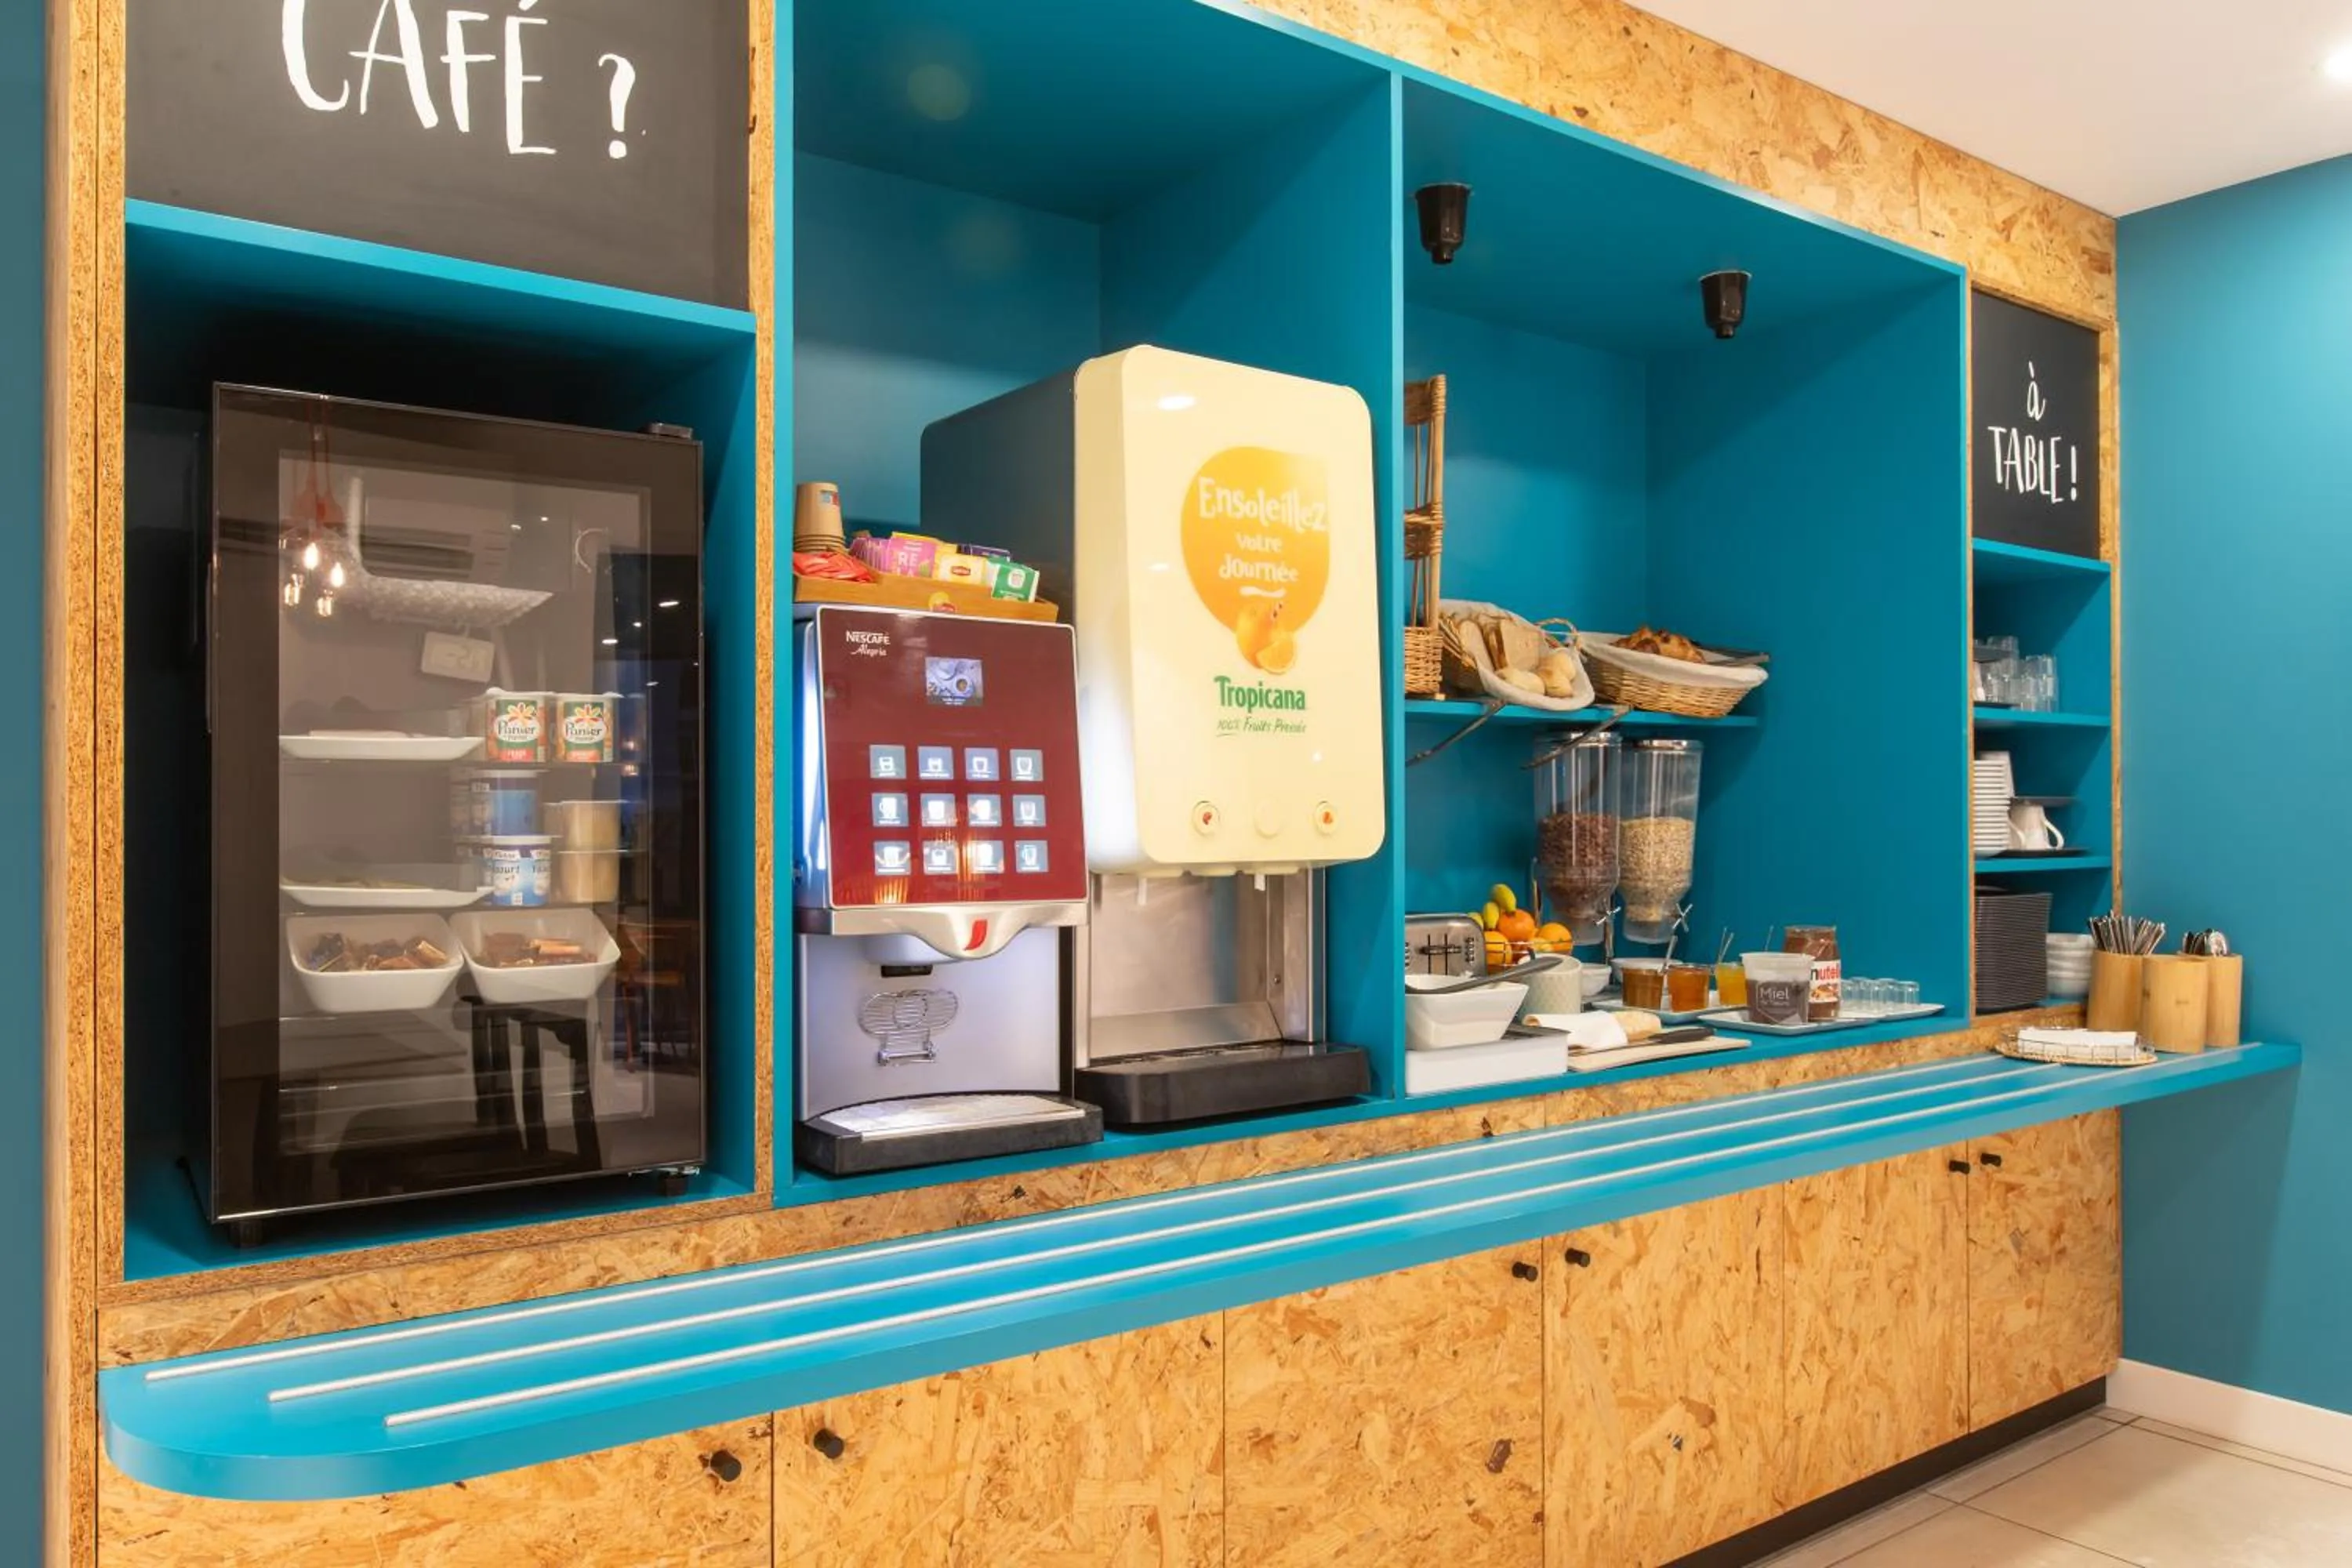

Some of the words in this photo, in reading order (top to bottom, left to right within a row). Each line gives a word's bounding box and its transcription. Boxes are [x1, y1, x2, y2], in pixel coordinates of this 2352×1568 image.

[1200, 477, 1326, 534] Ensoleillez
[1214, 675, 1305, 713] Tropicana
[1759, 987, 1790, 1000] Miel
